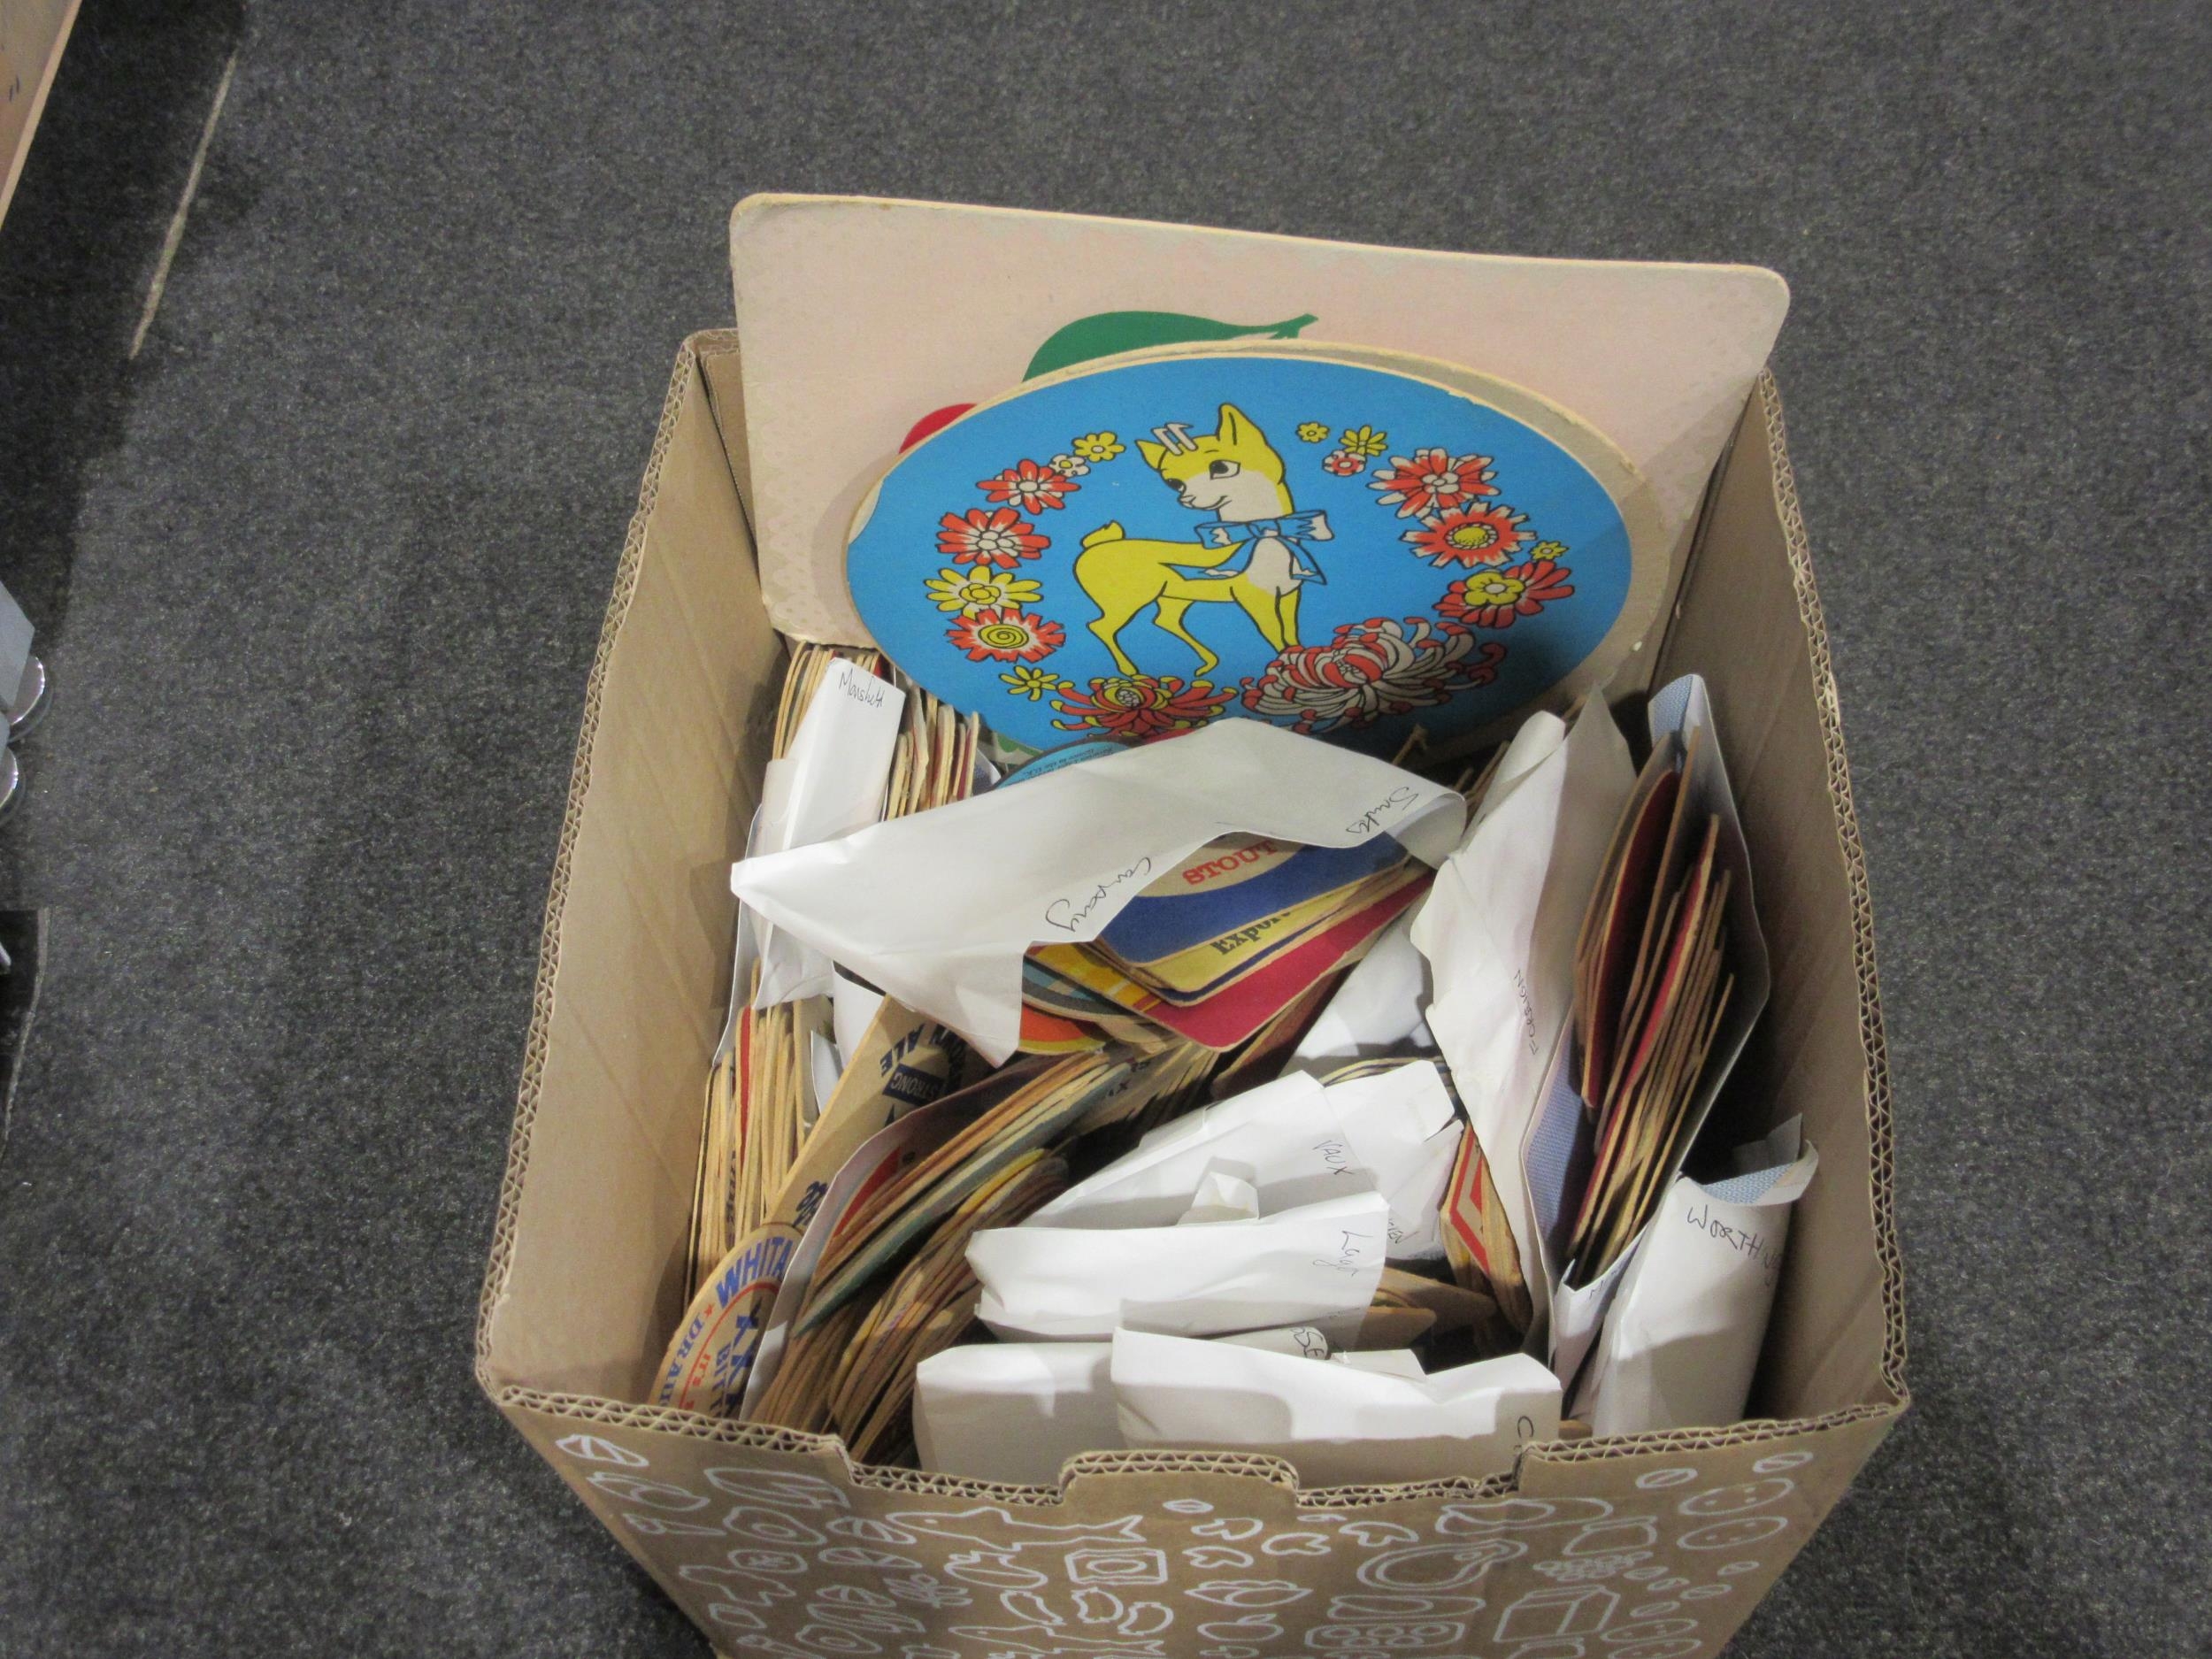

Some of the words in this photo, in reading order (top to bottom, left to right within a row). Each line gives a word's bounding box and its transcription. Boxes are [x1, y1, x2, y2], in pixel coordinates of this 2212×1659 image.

[1182, 840, 1279, 885] STOUT
[1210, 911, 1291, 956] Expo
[879, 1023, 926, 1078] ALE
[891, 1071, 939, 1099] STRONG
[1312, 1139, 1355, 1175] VAUX
[716, 1236, 794, 1310] WHITA
[658, 1312, 705, 1409] DRAU
